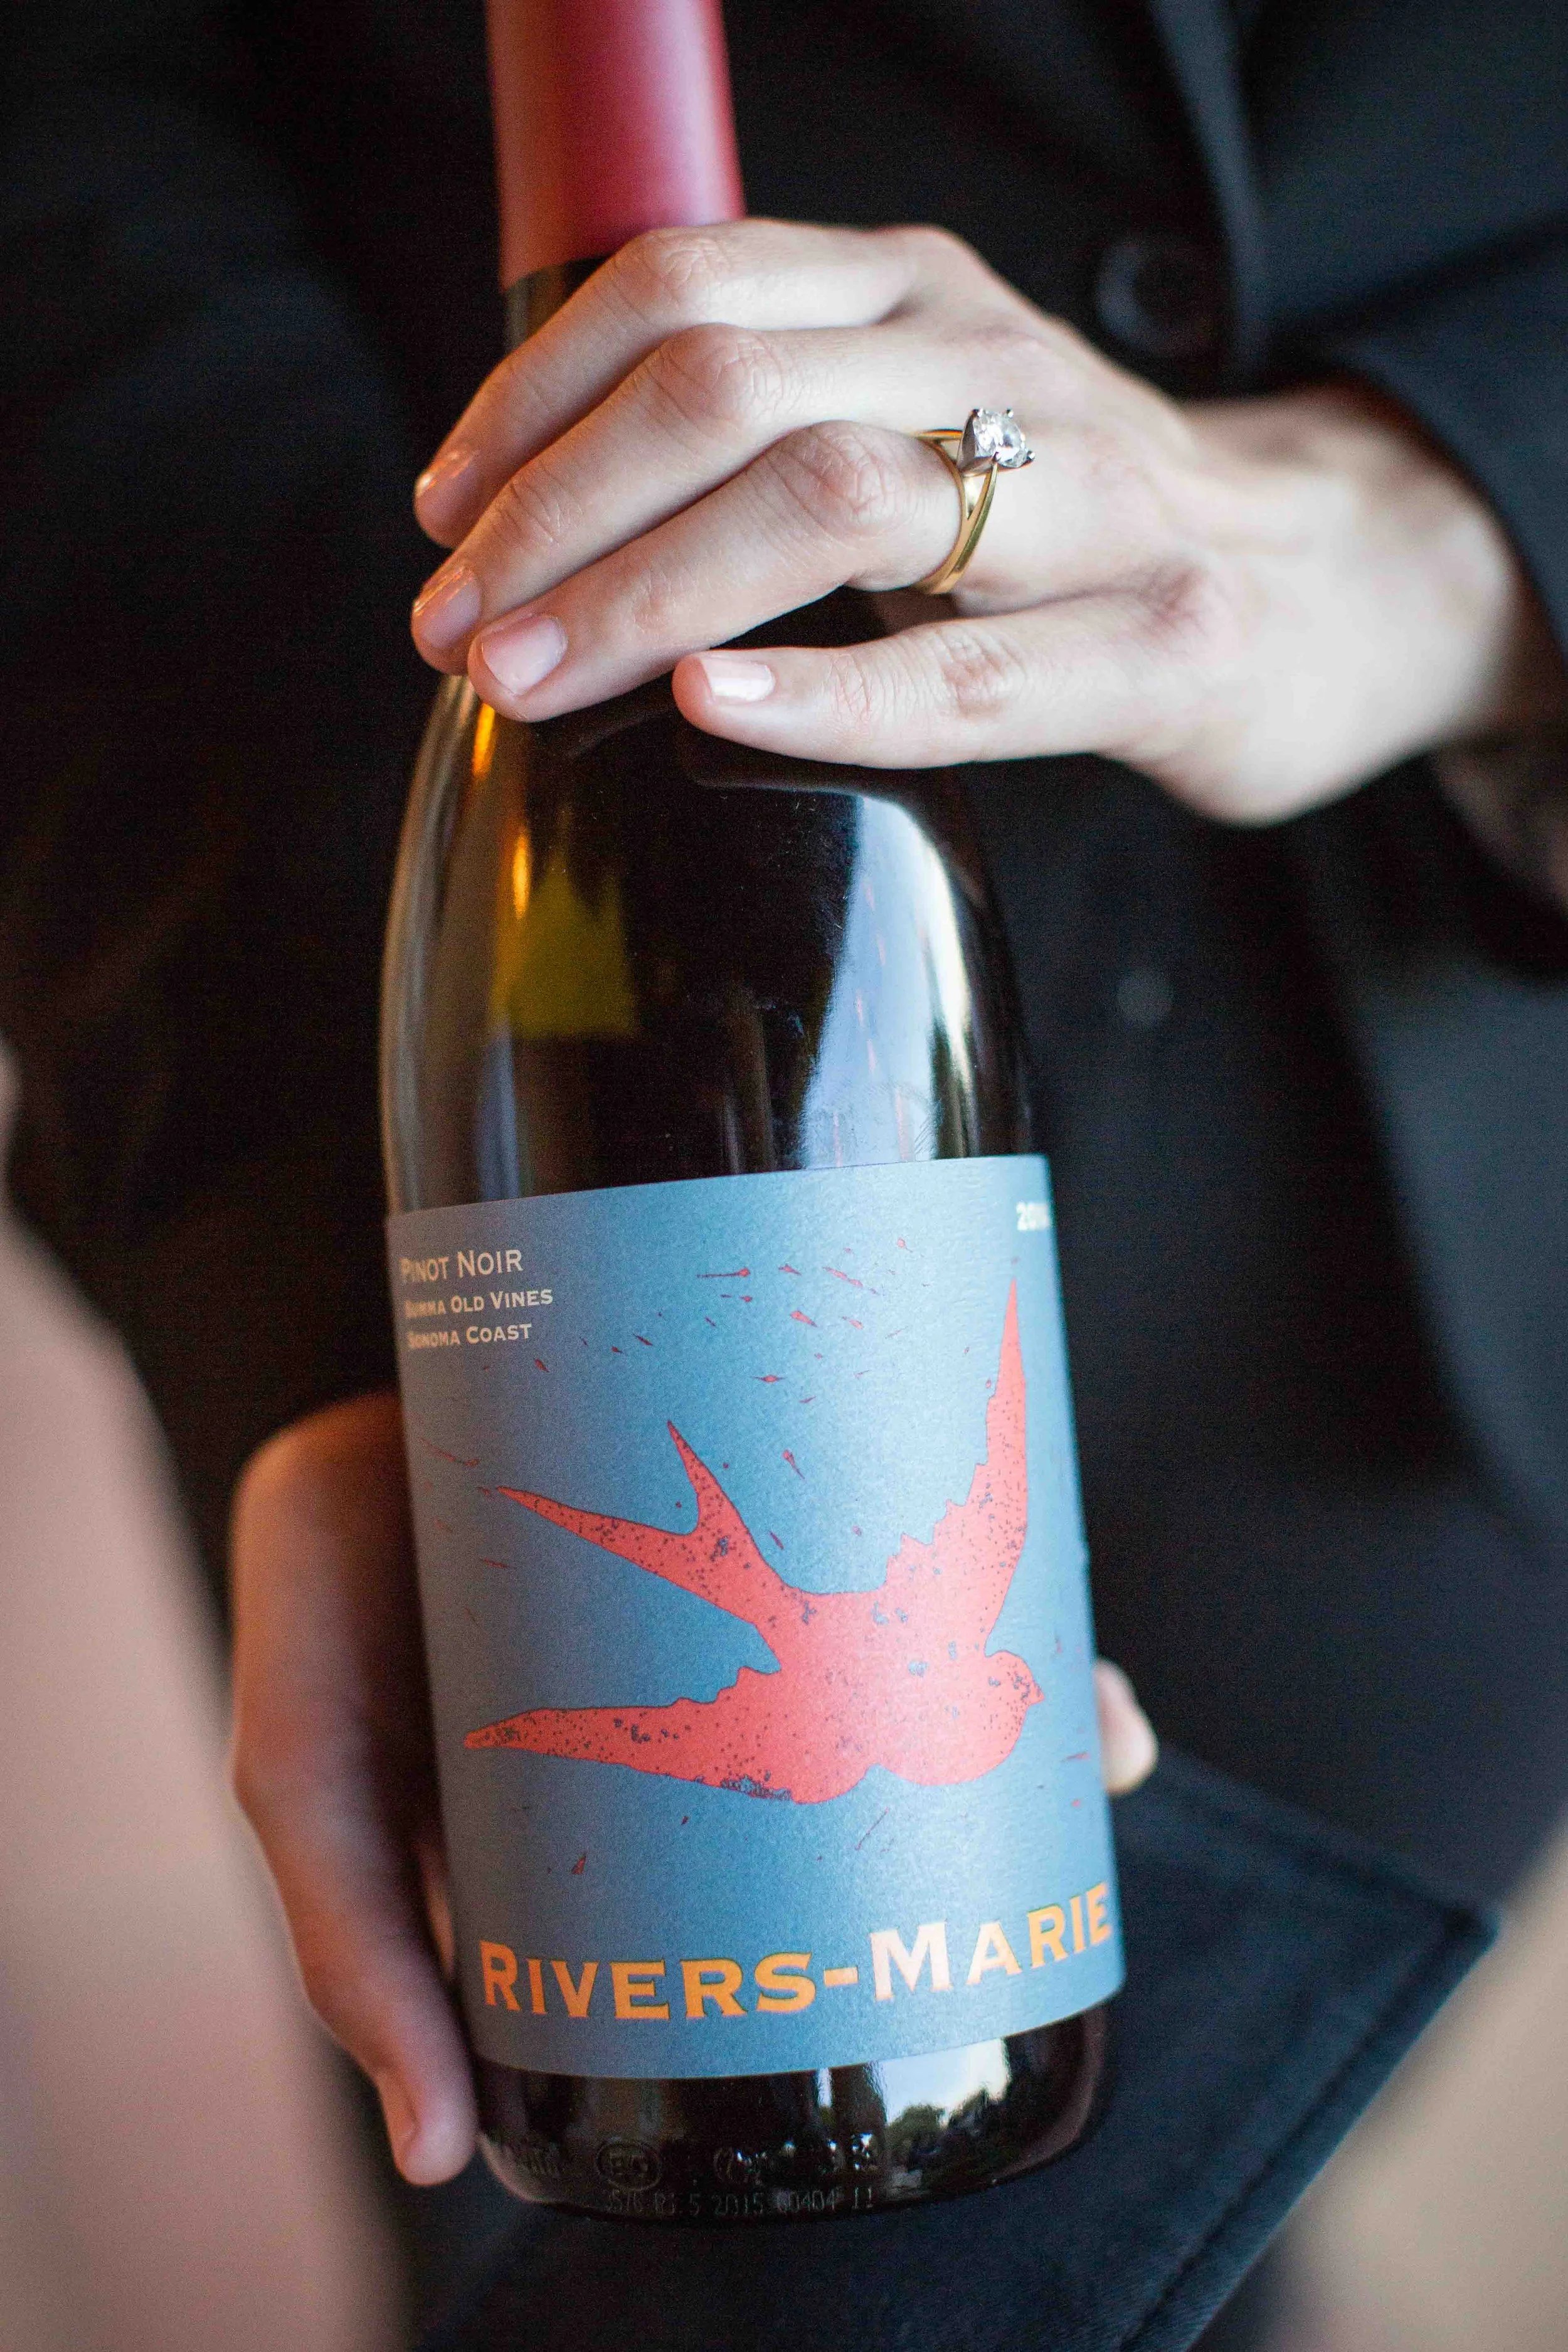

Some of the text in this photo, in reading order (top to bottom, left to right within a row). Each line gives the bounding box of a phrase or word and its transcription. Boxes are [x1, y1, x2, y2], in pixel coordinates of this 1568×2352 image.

[399, 1249, 523, 1283] PINOT NOIR
[450, 1295, 484, 1313] OLD
[490, 1289, 553, 1309] VINES
[466, 1323, 532, 1344] COAST
[479, 1881, 1111, 2021] RIVERS-MARIE
